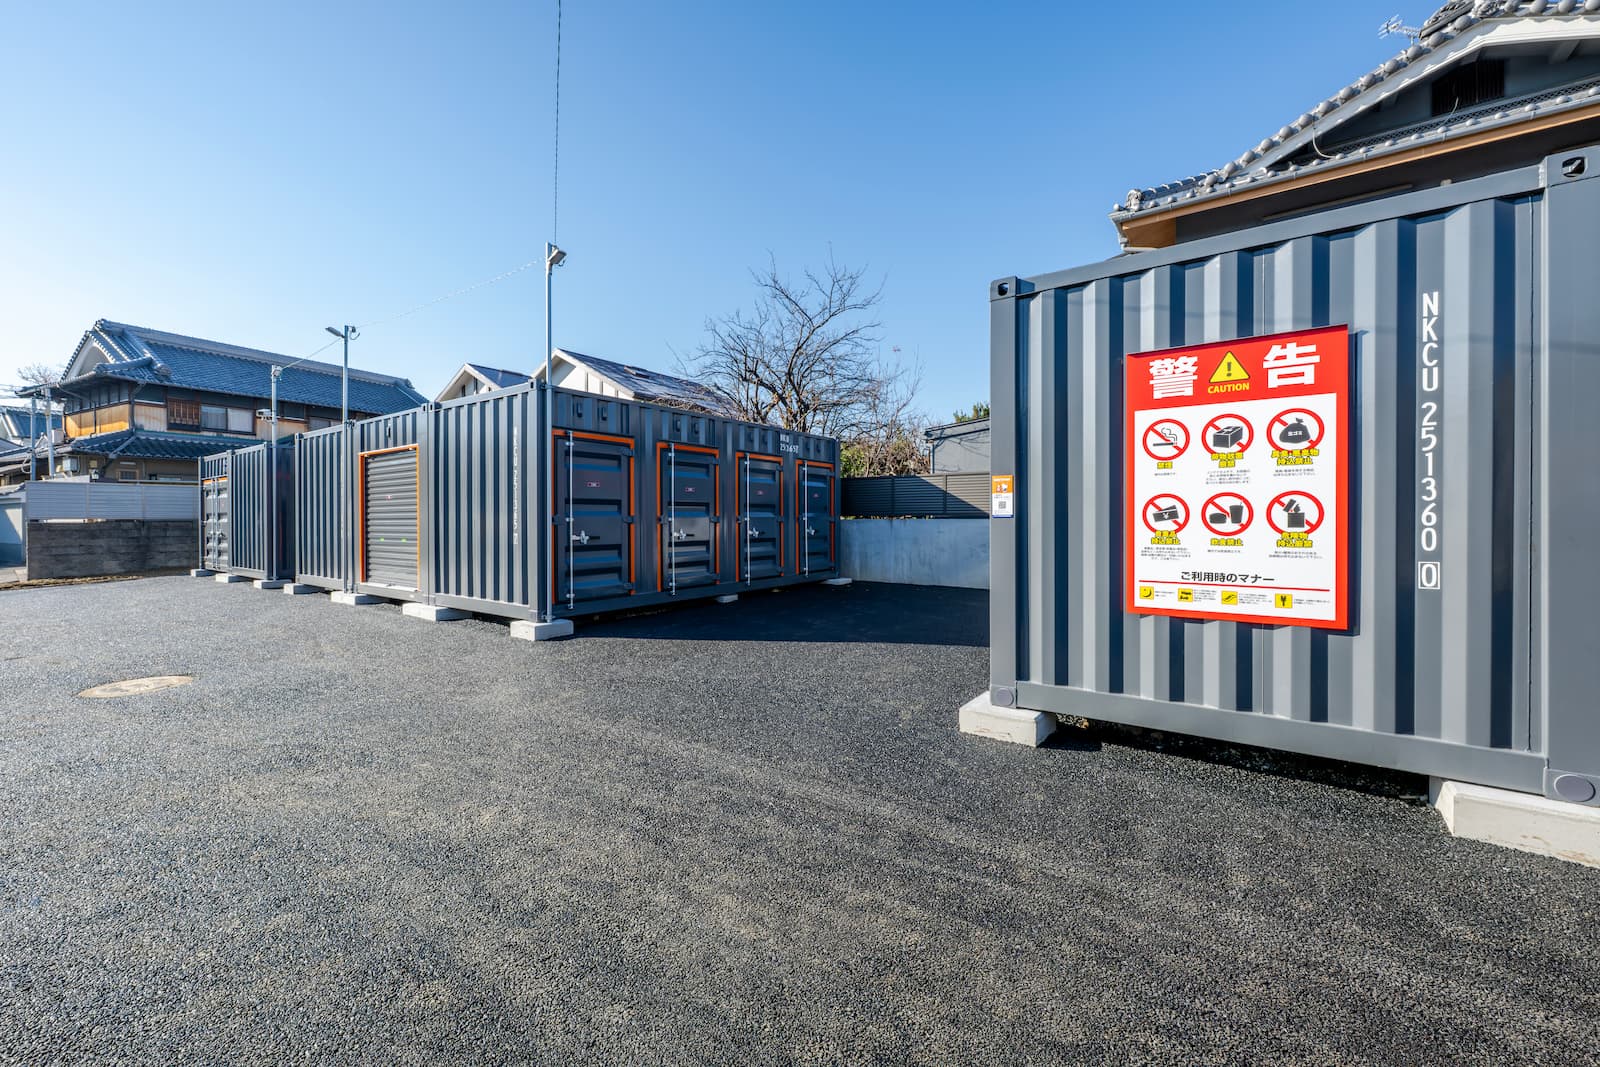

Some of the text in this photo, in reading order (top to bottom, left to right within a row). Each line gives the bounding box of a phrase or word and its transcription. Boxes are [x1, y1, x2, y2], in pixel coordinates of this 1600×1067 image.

[1207, 382, 1250, 394] CAUTION
[1419, 291, 1440, 589] NKCU 251360 0
[1180, 571, 1275, 584] ご利用時のマナー
